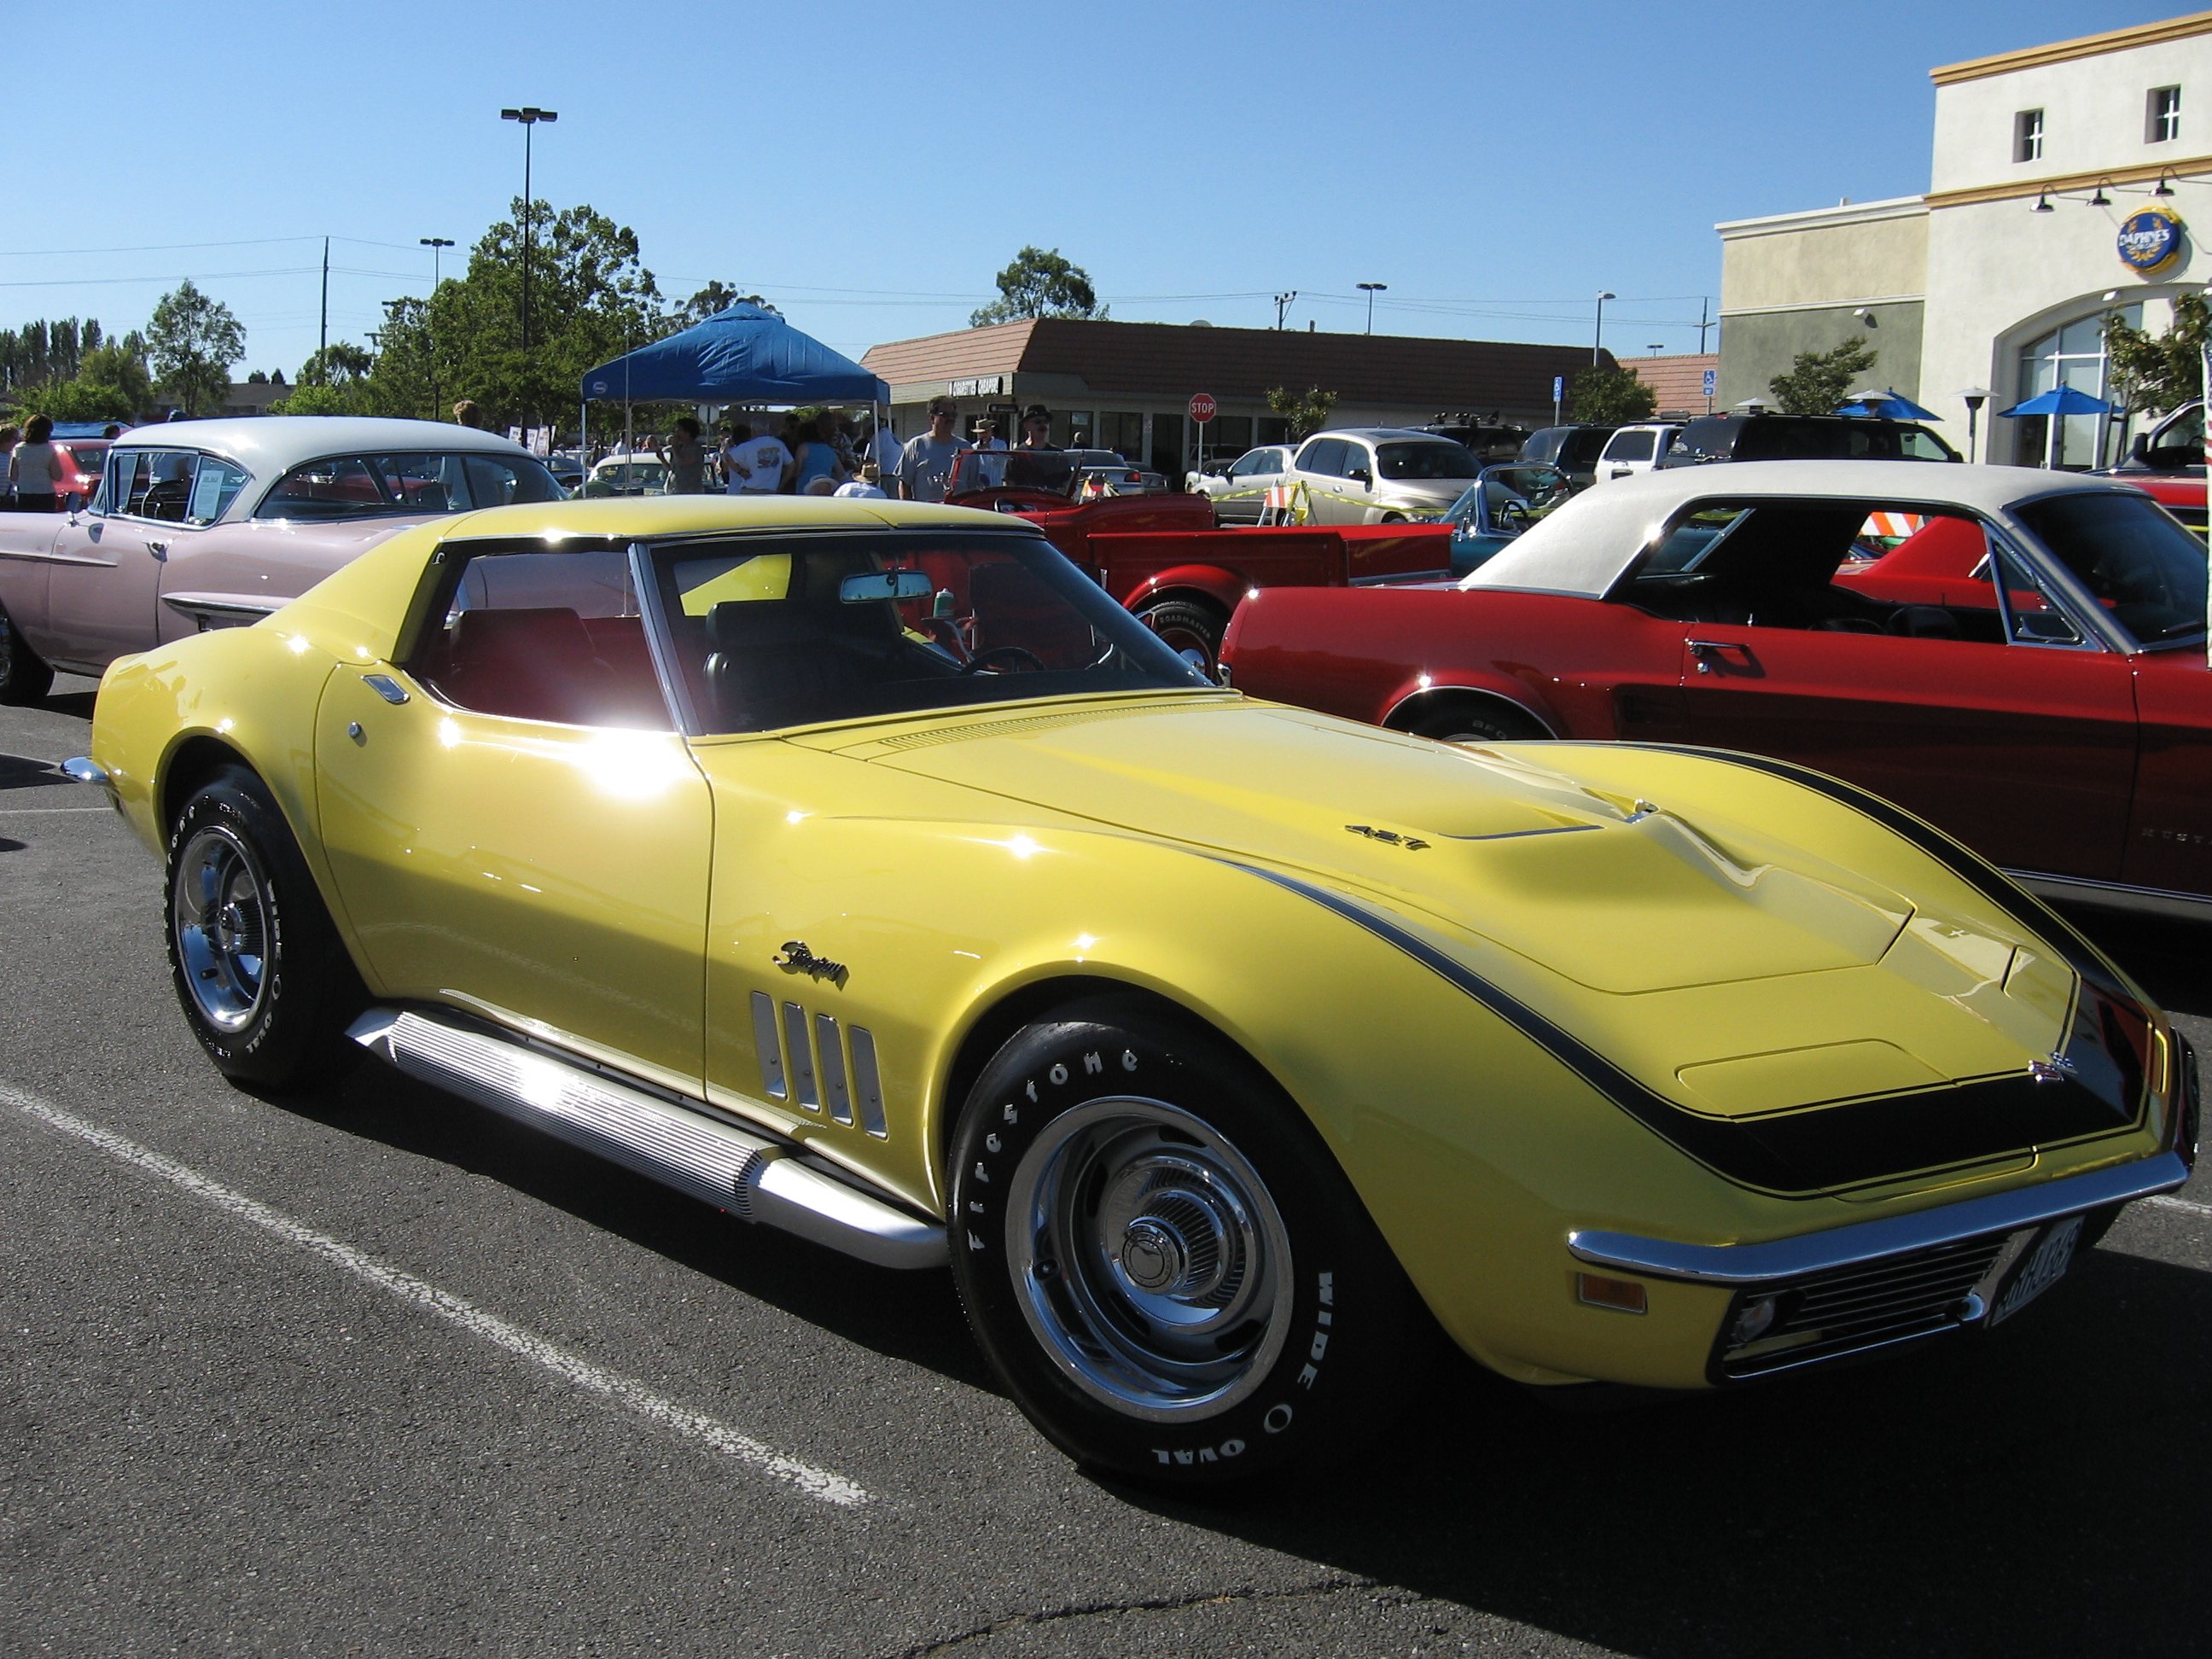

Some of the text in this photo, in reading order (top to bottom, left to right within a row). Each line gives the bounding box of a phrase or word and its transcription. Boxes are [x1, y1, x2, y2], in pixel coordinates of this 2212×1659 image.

[1191, 402, 1214, 413] STOP
[1345, 825, 1431, 851] 427
[2140, 827, 2212, 845] MUST
[1297, 1272, 1334, 1390] WIDE
[1153, 1439, 1246, 1464] OVAL
